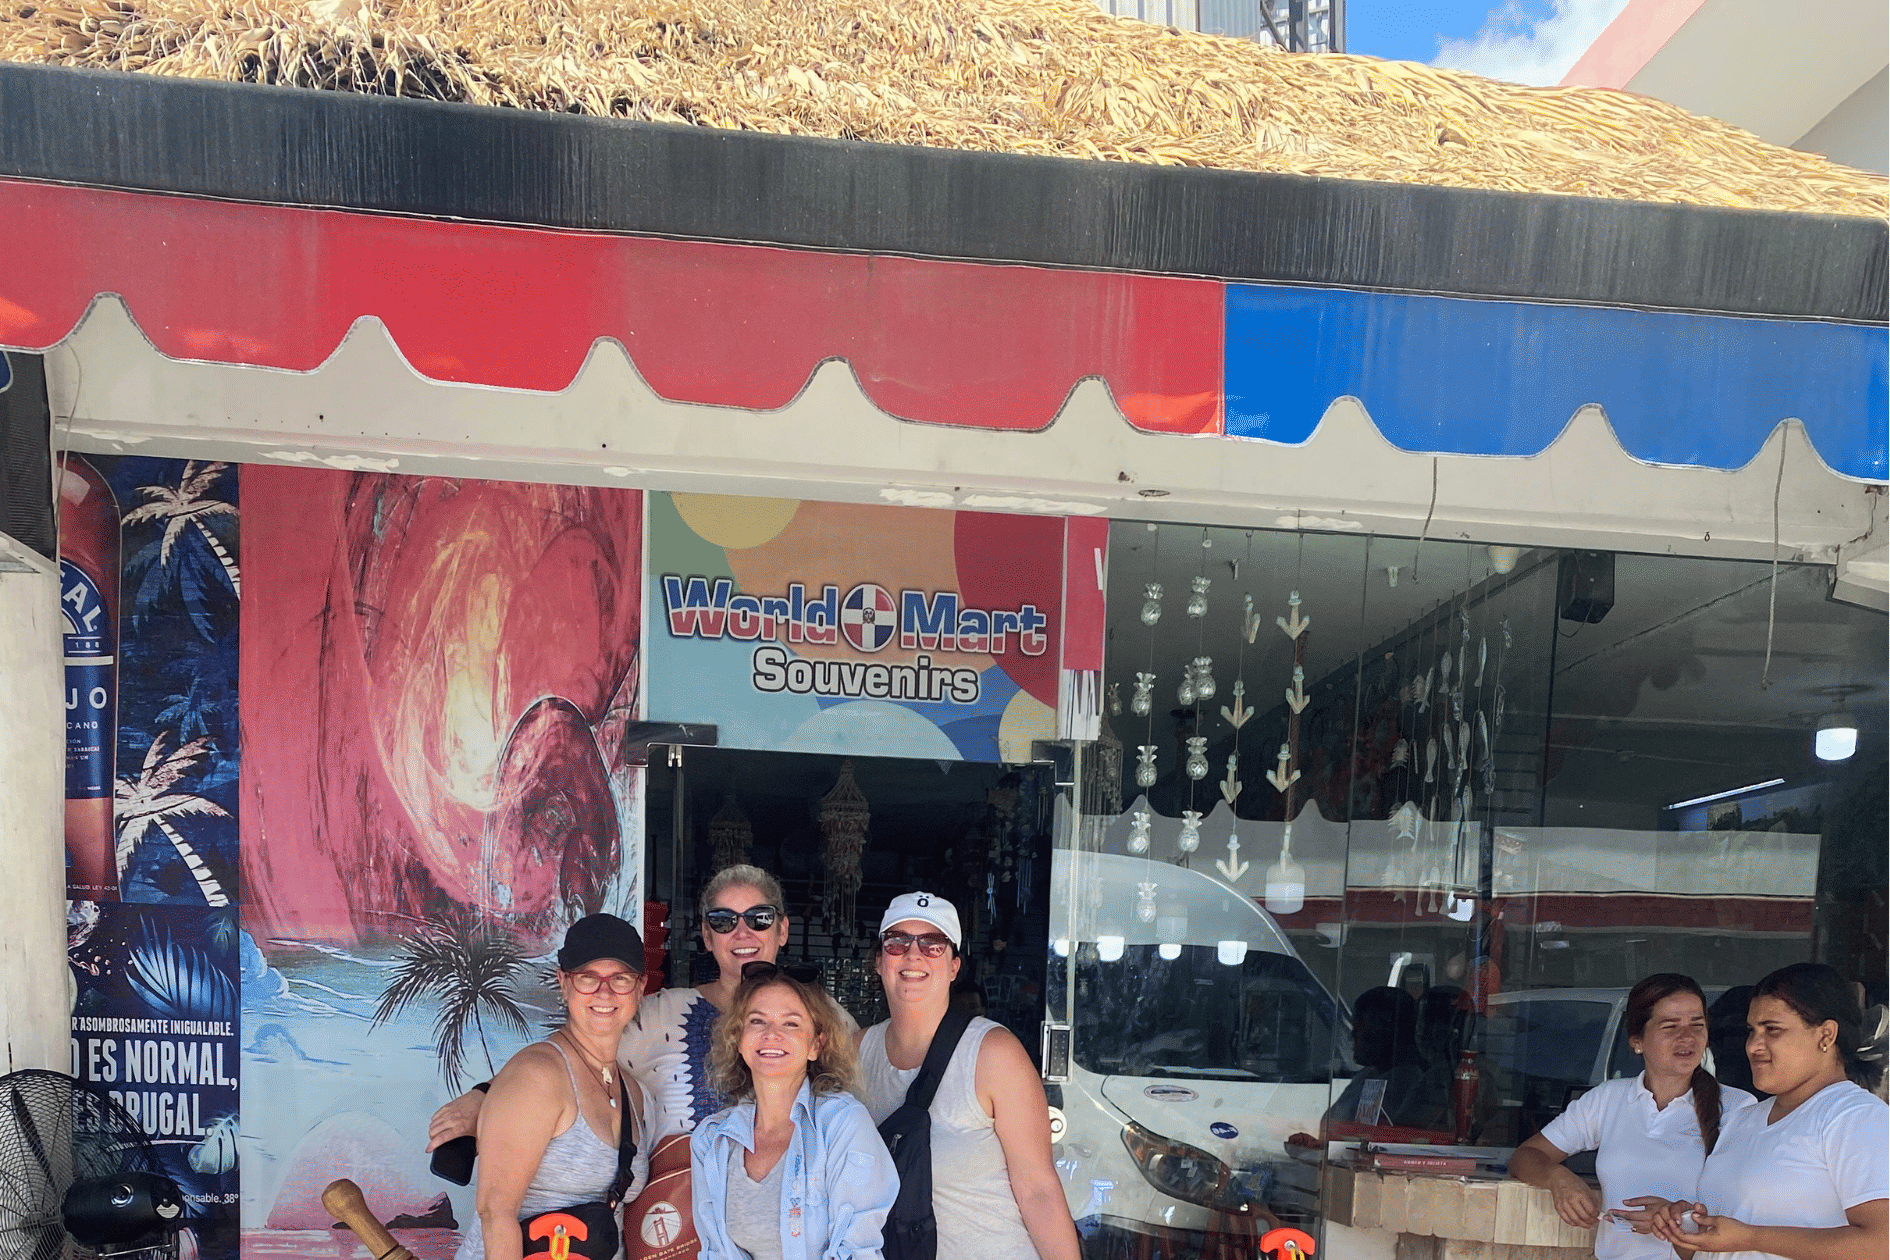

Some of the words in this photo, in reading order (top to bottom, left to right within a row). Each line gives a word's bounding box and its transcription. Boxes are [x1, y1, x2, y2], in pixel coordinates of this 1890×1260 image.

[662, 575, 838, 645] World
[900, 589, 1047, 656] Mart
[753, 646, 978, 703] Souvenirs
[79, 1017, 168, 1034] ASOMBROSAMENTE
[170, 1019, 234, 1036] INIGUALABLE.
[88, 1038, 117, 1082] ES
[125, 1039, 237, 1091] NORMAL,
